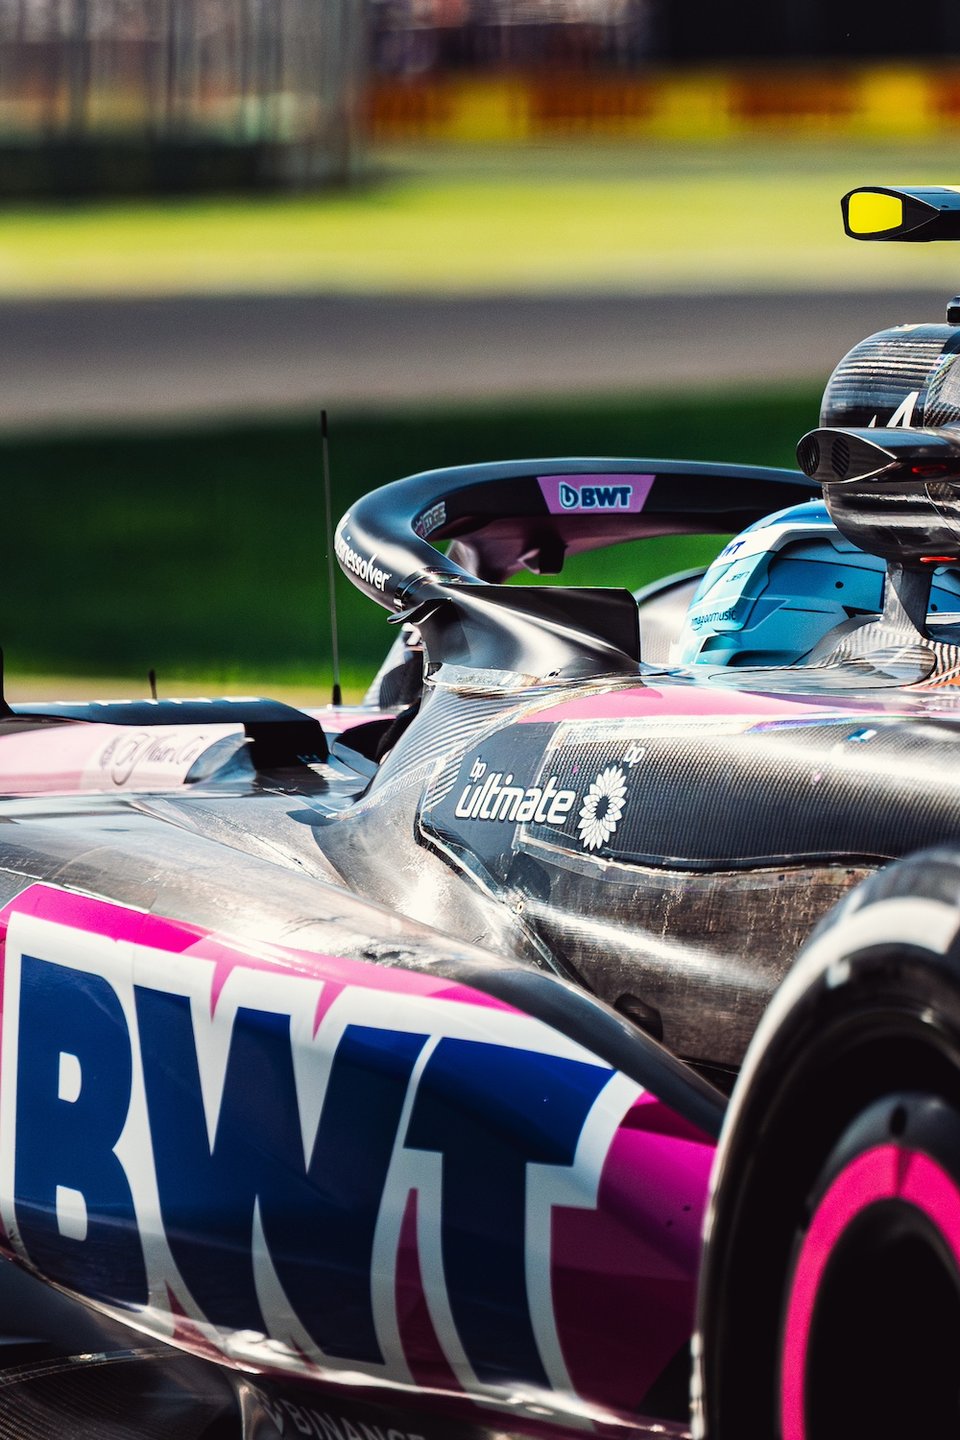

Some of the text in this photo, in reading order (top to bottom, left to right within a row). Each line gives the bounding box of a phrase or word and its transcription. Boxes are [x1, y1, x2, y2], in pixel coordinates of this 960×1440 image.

[580, 485, 632, 508] BWT
[469, 756, 487, 782] bp
[622, 744, 647, 768] bp
[454, 772, 577, 825] ultimate
[12, 952, 619, 1398] BWT
